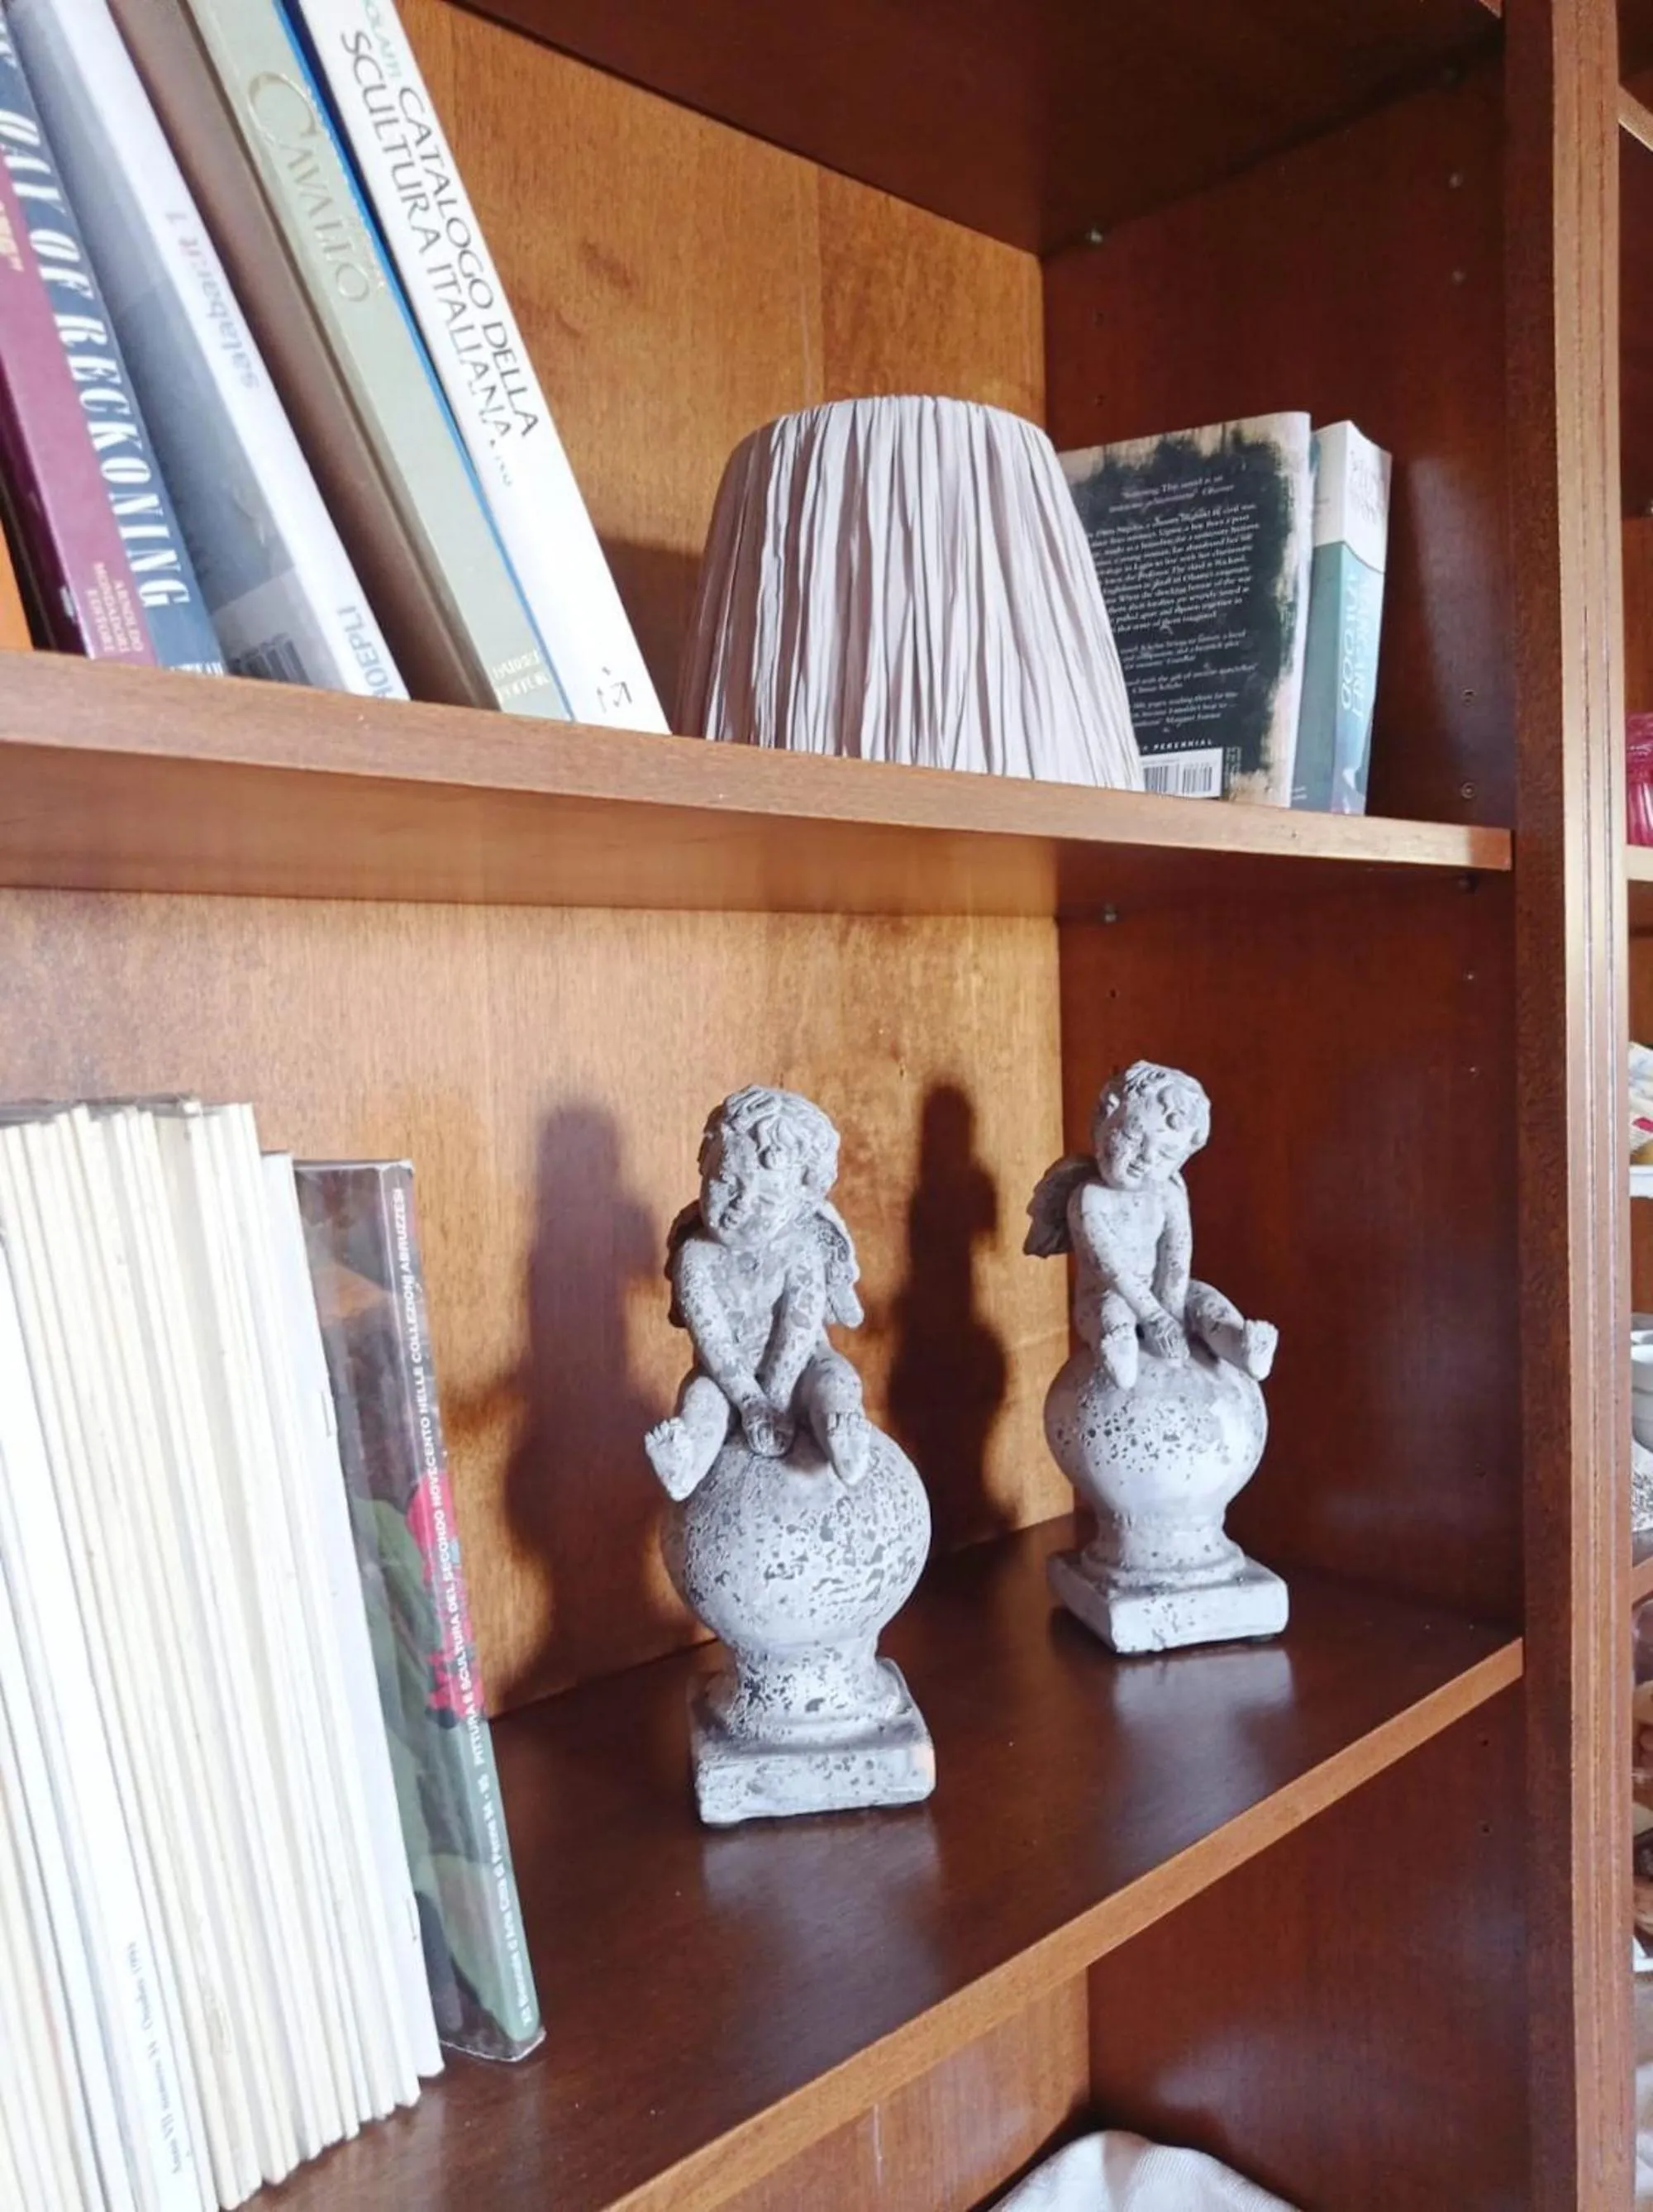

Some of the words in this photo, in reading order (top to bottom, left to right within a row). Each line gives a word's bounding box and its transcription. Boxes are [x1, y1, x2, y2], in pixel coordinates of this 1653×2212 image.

[29, 228, 95, 299] OF
[341, 29, 441, 255] SCULTURA
[427, 262, 512, 447] ITALIANA
[398, 86, 494, 309] CATALOGO
[482, 321, 539, 438] DELLA
[55, 314, 190, 608] RECKONING
[93, 561, 131, 653] MONDADORI
[114, 579, 145, 652] ARNOLDO
[1153, 738, 1213, 751] PERENNIAL
[392, 1187, 412, 1274] ABRUZZESI
[402, 1274, 422, 1364] COLLEZIONI
[412, 1366, 429, 1413] NELLE
[418, 1415, 443, 1508] NOVECENTO
[432, 1509, 454, 1581] SECONDO
[443, 1582, 458, 1613] DEL
[450, 1613, 473, 1691] SCULTURA
[464, 1702, 486, 1766] PITTURA
